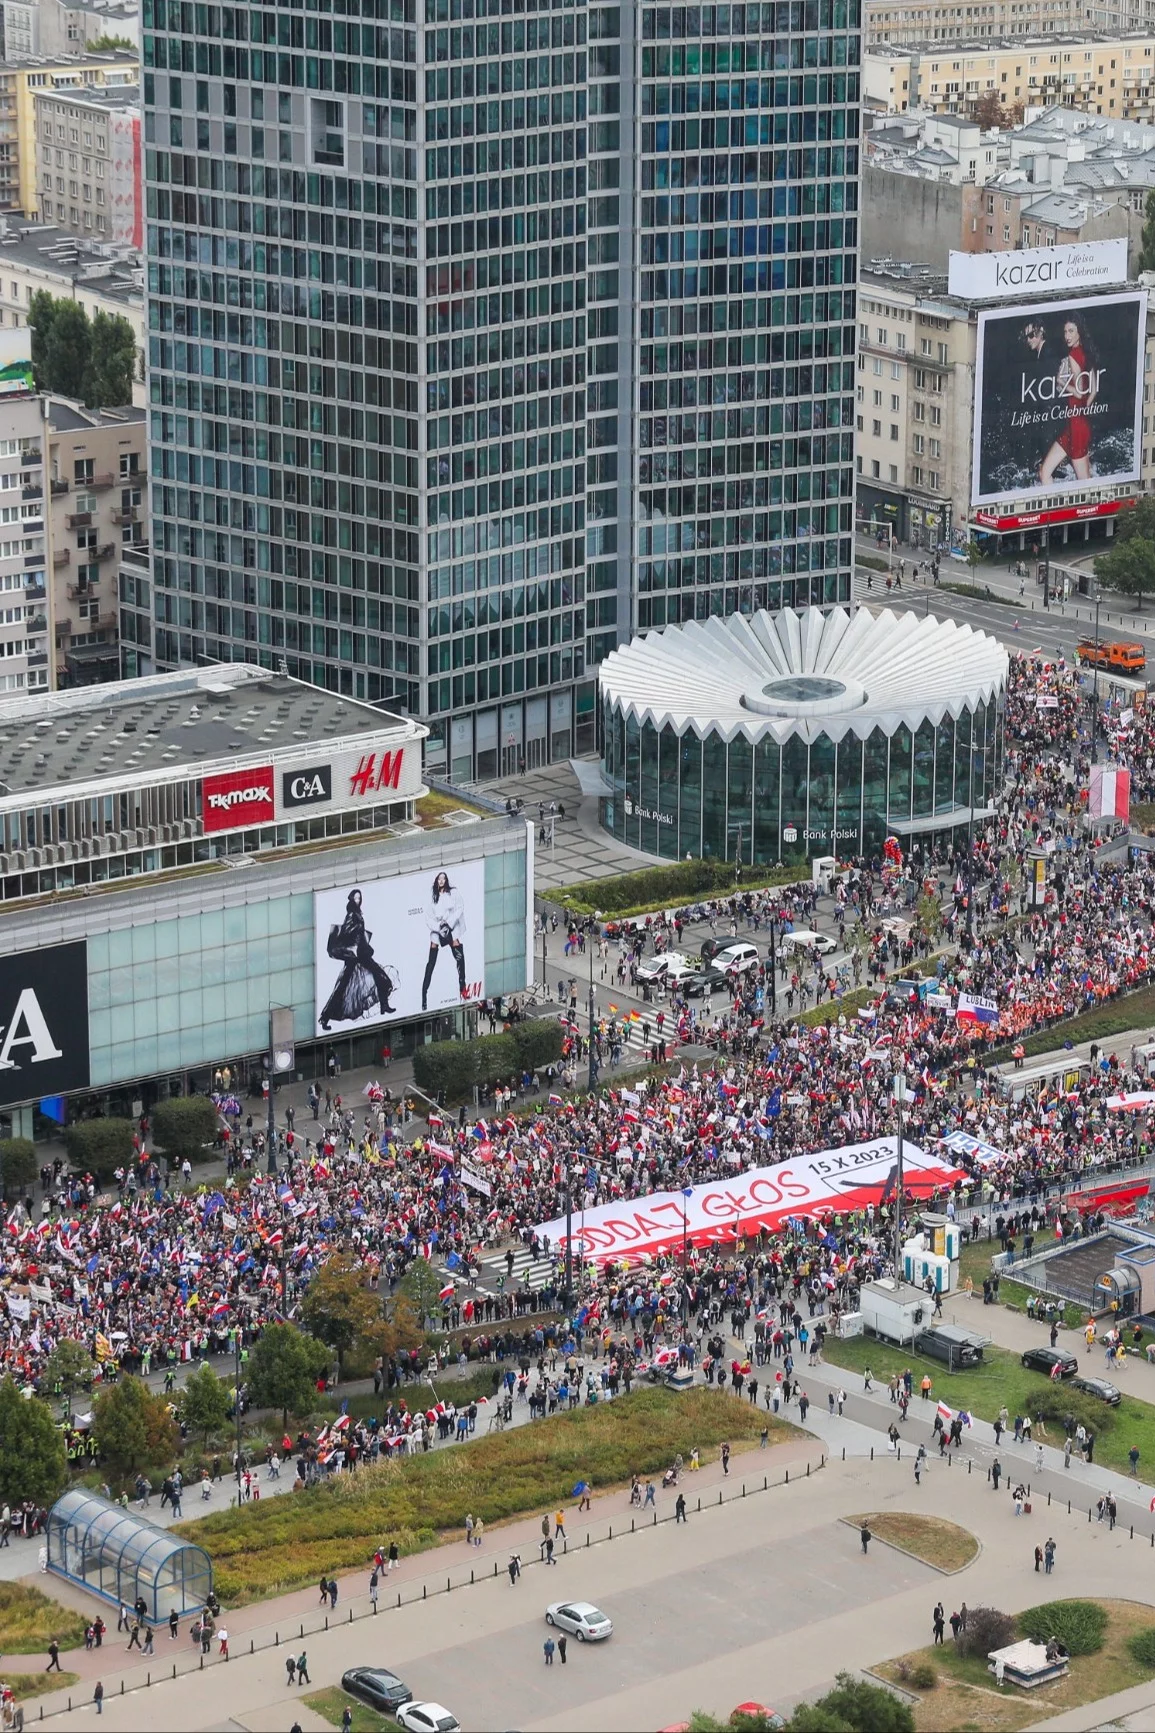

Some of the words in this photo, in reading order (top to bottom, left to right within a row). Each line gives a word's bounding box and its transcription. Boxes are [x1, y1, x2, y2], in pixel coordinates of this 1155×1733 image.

[1066, 265, 1109, 279] Celebration
[1067, 255, 1082, 265] Life
[996, 260, 1062, 287] kazar
[1021, 368, 1107, 403] kazar
[1011, 410, 1031, 428] Life
[1032, 411, 1041, 423] is
[1050, 402, 1109, 421] Celebration
[1018, 515, 1041, 523] SUPERBET
[350, 748, 404, 796] H&M
[290, 774, 326, 799] C&A
[634, 804, 651, 818] Bank
[652, 811, 673, 825] Polski
[802, 830, 826, 840] Bank
[830, 829, 857, 839] Polski
[966, 995, 1004, 1009] LUBLIN
[808, 1161, 832, 1176] 15
[833, 1156, 850, 1169] X
[849, 1146, 894, 1164] 2023
[559, 1202, 691, 1253] ODDAJ
[701, 1170, 811, 1218] GŁOS
